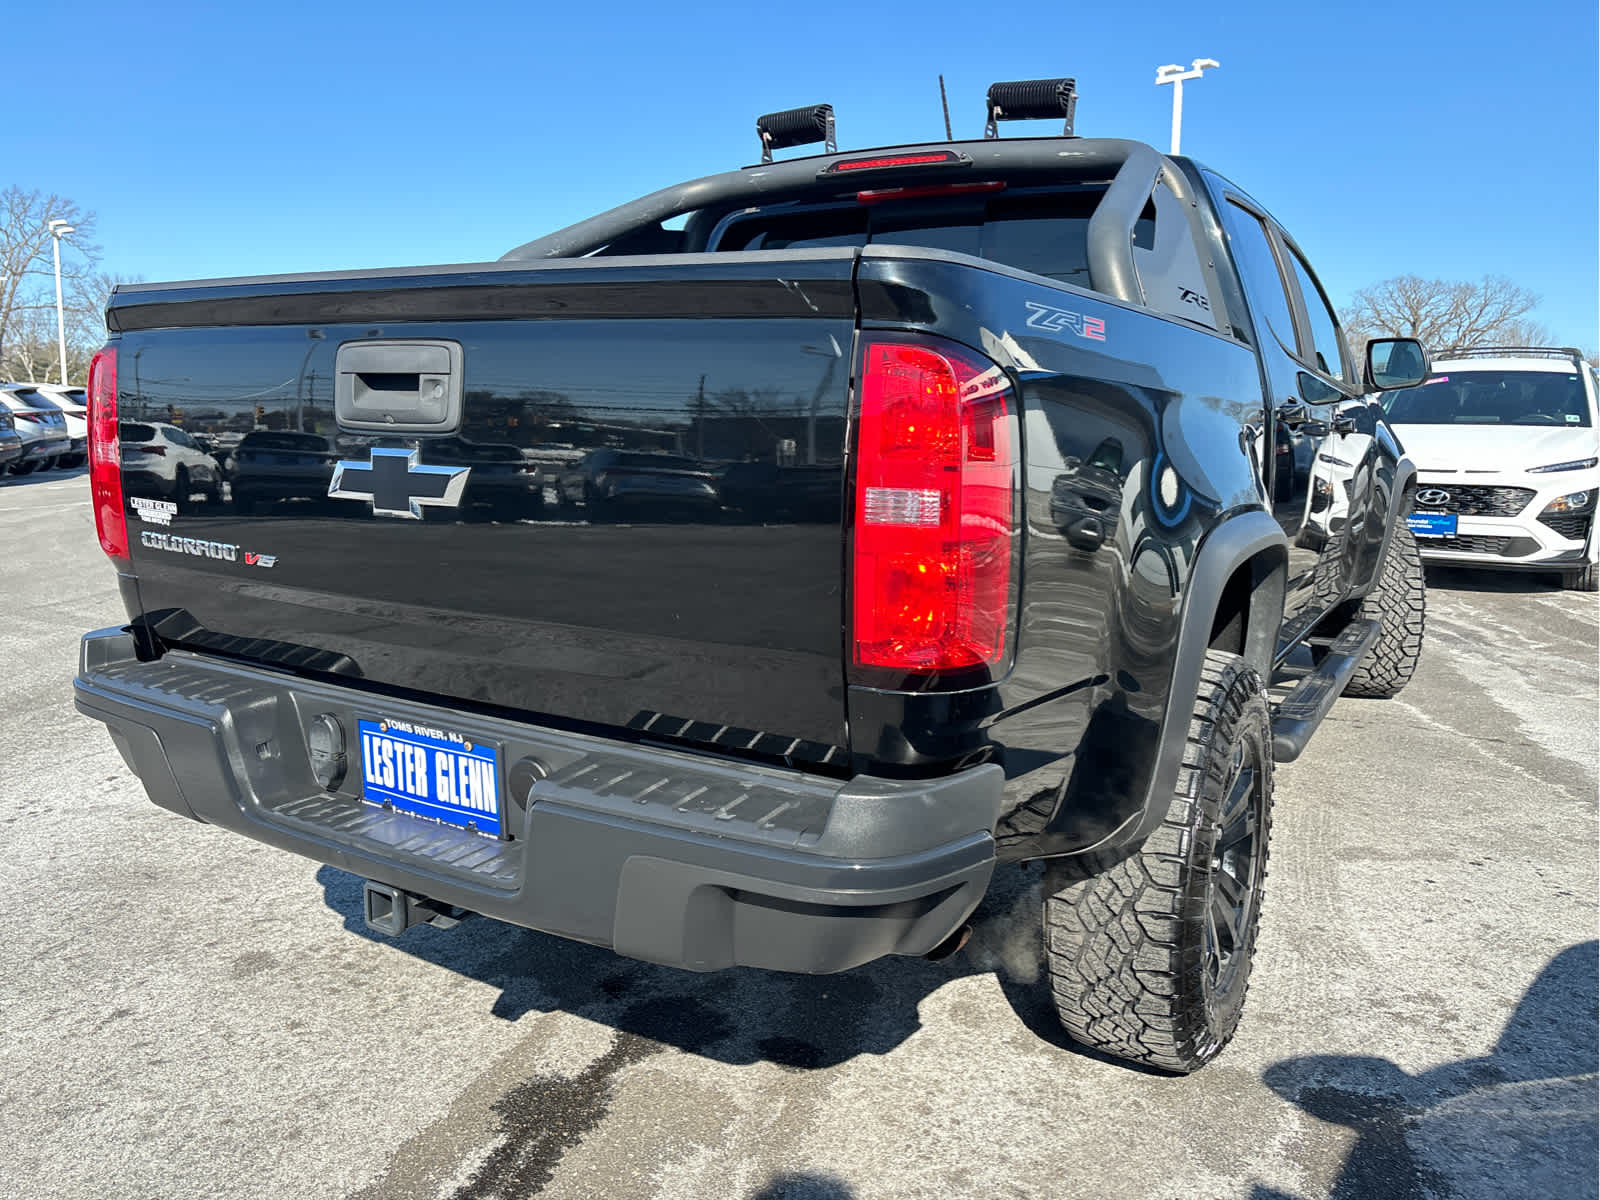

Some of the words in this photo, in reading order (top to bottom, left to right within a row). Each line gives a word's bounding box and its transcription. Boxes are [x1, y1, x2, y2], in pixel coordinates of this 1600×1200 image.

[1025, 301, 1106, 342] ZR2
[141, 530, 237, 561] COLORADO
[245, 552, 277, 567] V6
[384, 718, 413, 734] TOMS
[449, 732, 464, 744] NJ
[363, 734, 428, 798] LESTER
[435, 751, 497, 814] GLENN
